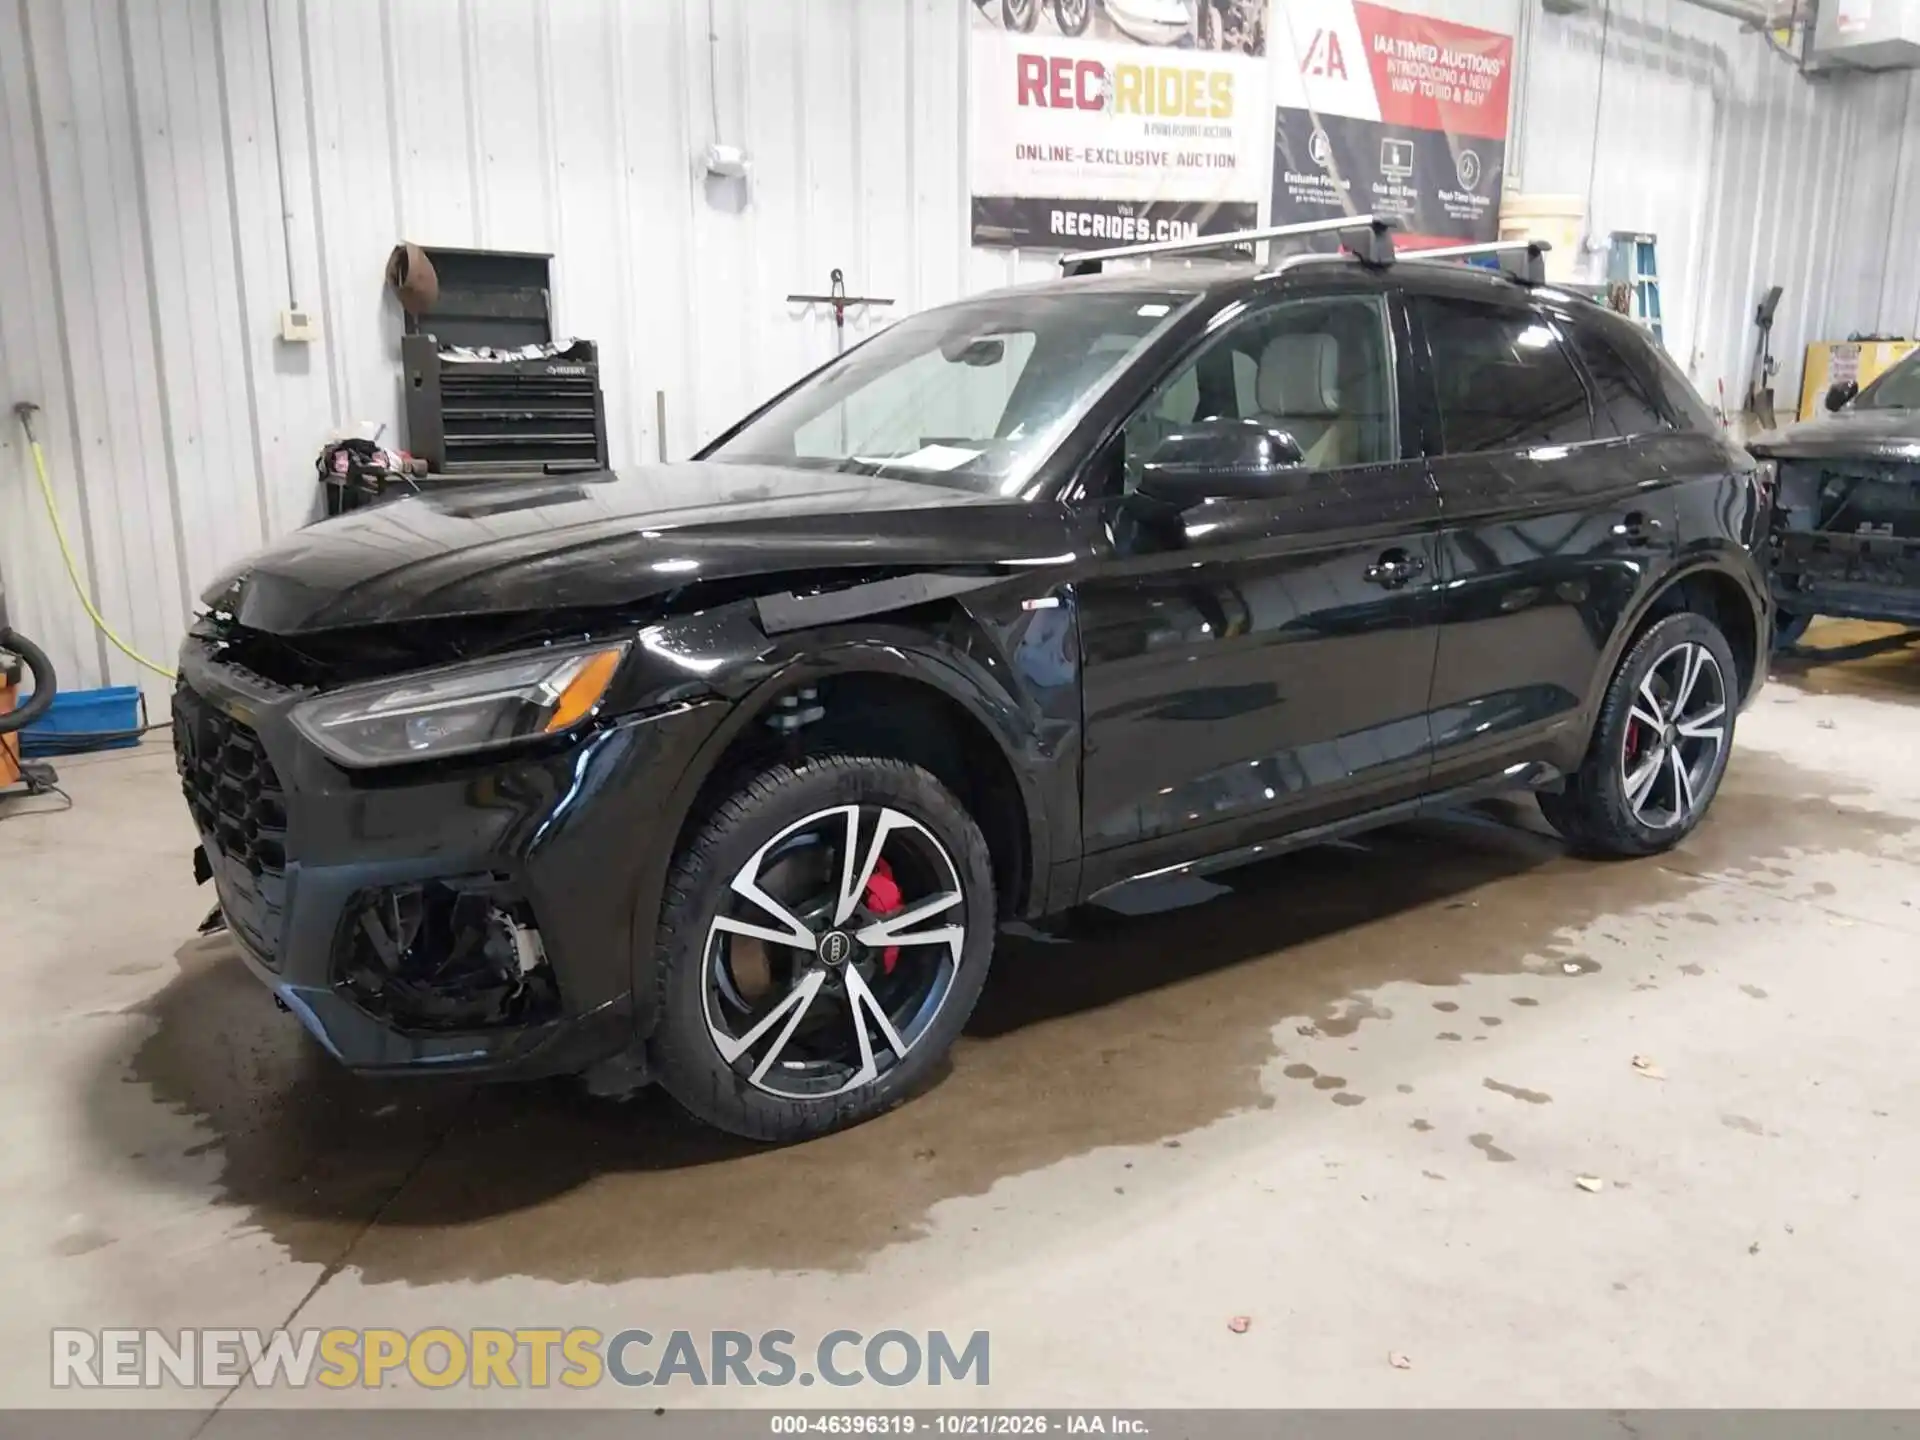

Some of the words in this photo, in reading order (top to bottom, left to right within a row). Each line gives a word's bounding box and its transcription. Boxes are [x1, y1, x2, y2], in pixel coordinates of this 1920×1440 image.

[1374, 34, 1394, 54] IAA
[1396, 38, 1437, 64] TIMED
[1440, 48, 1501, 77] AUCTIONS
[1017, 54, 1105, 111] REC
[1115, 64, 1234, 119] RIDES
[1387, 57, 1457, 86] INTRODUCING
[1458, 72, 1467, 86] A
[1469, 73, 1492, 93] NEW
[1391, 75, 1417, 95] WAY
[1420, 80, 1434, 98] TO
[1463, 88, 1485, 106] BUY
[1015, 143, 1169, 168] ONLINE-EXCLUSIVE
[1177, 151, 1237, 169] AUCTION
[1050, 210, 1199, 242] RECRIDES.COM
[1118, 204, 1134, 217] Visit
